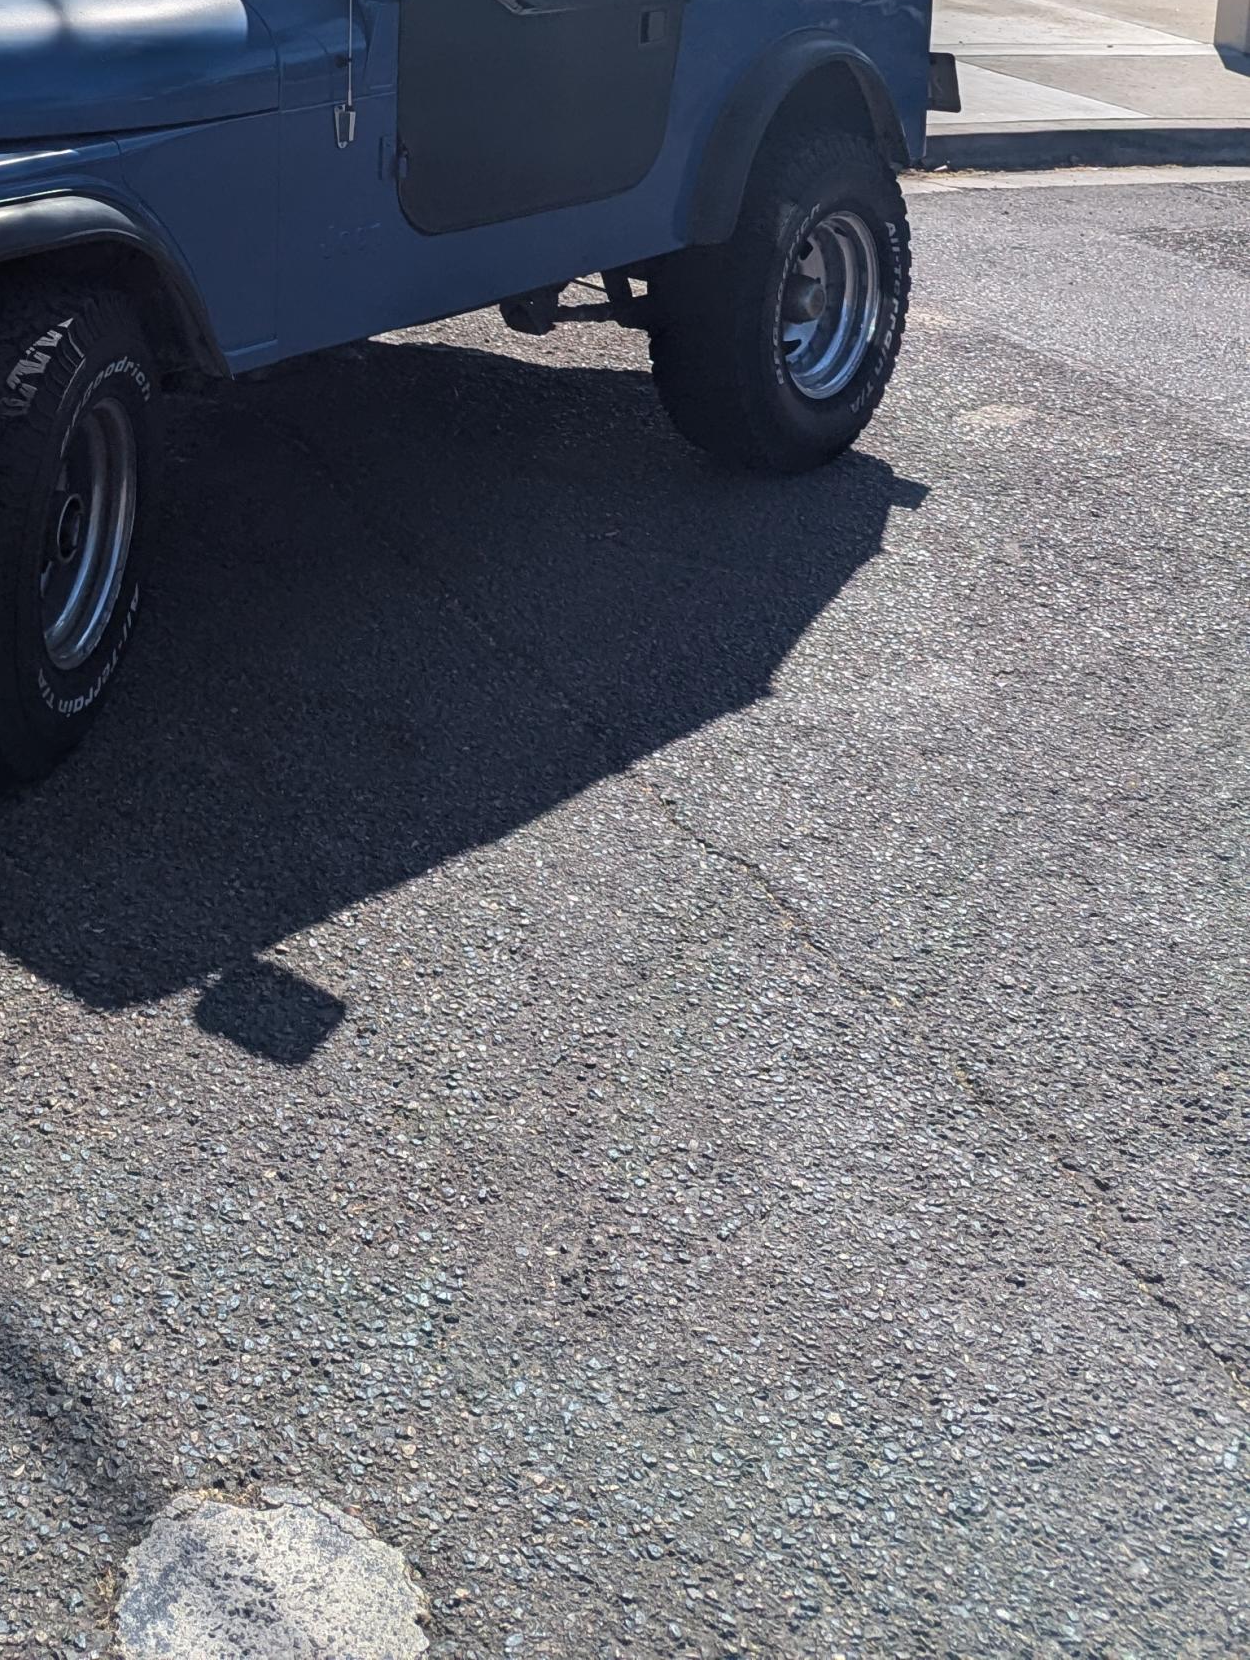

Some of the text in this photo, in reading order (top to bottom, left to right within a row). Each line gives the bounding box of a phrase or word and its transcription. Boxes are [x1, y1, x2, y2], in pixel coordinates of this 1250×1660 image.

[850, 221, 902, 413] All-Terrain T/A
[58, 582, 139, 719] All-Terrain
